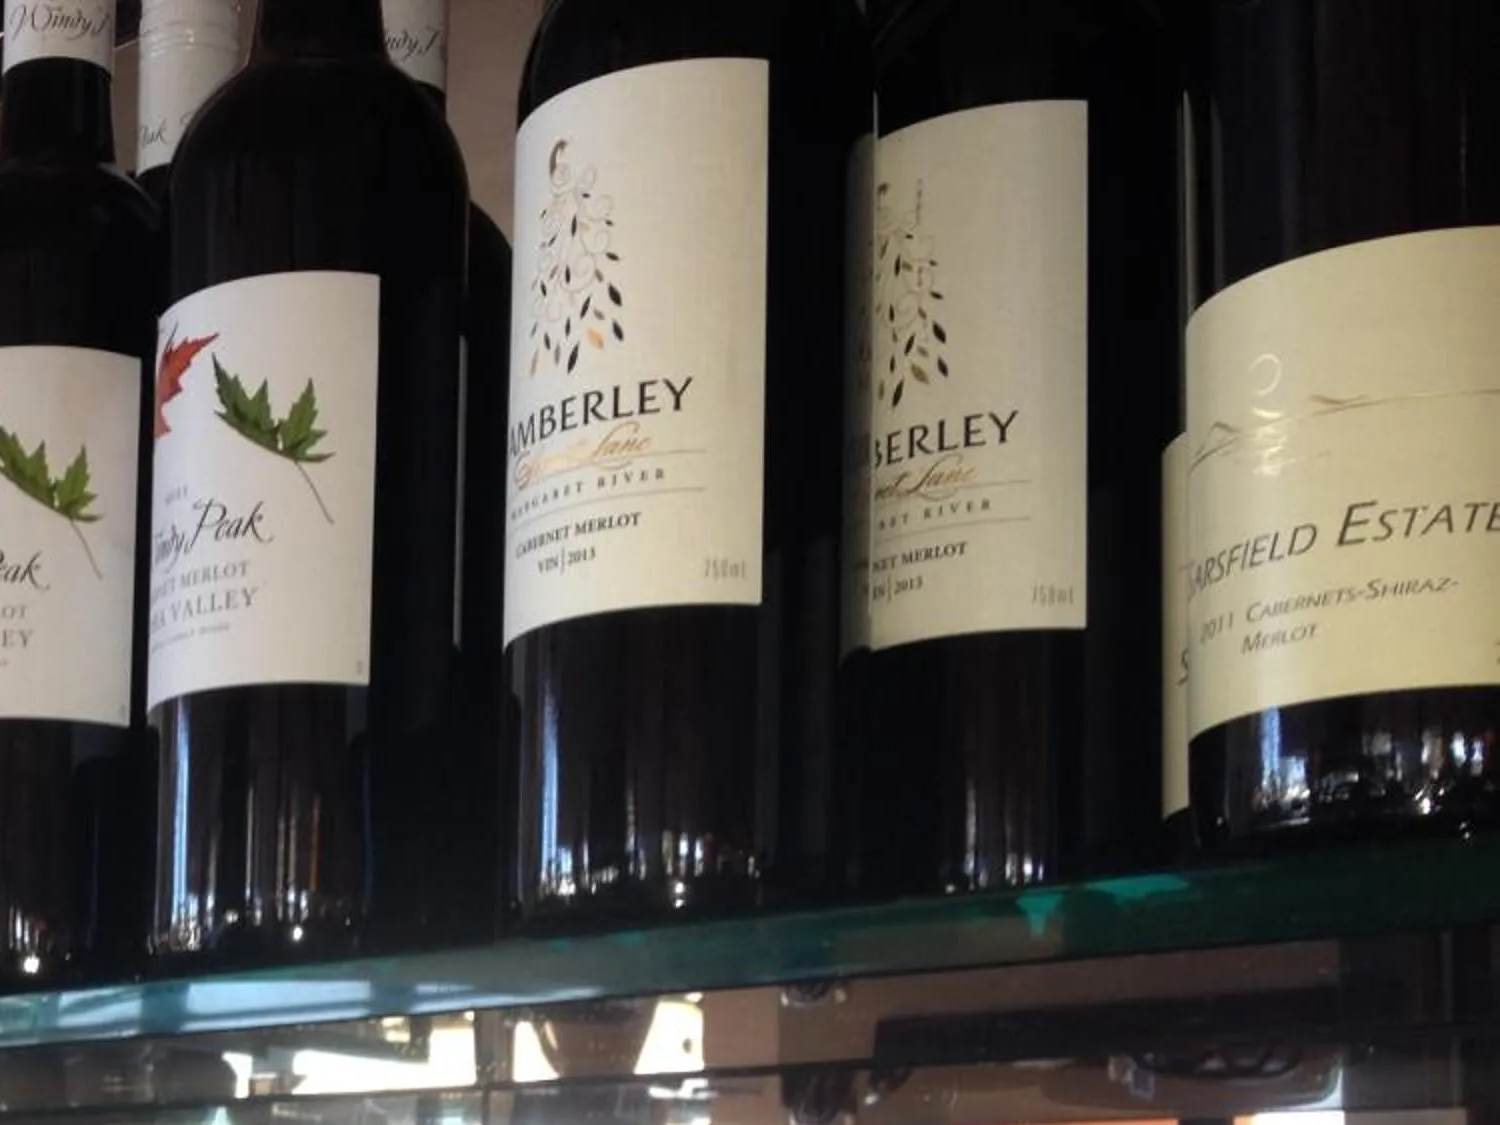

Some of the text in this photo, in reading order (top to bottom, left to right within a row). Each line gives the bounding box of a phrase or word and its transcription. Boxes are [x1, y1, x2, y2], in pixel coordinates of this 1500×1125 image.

[509, 376, 693, 458] AMBERLEY
[597, 467, 666, 488] RIVER
[924, 498, 992, 520] RIVER
[186, 497, 274, 553] Peak
[573, 511, 642, 537] MERLOT
[567, 545, 597, 568] 2013
[901, 541, 967, 567] MERLOT
[180, 559, 250, 587] MERLOT
[170, 586, 259, 623] VALLEY
[1241, 622, 1319, 655] MERLOT
